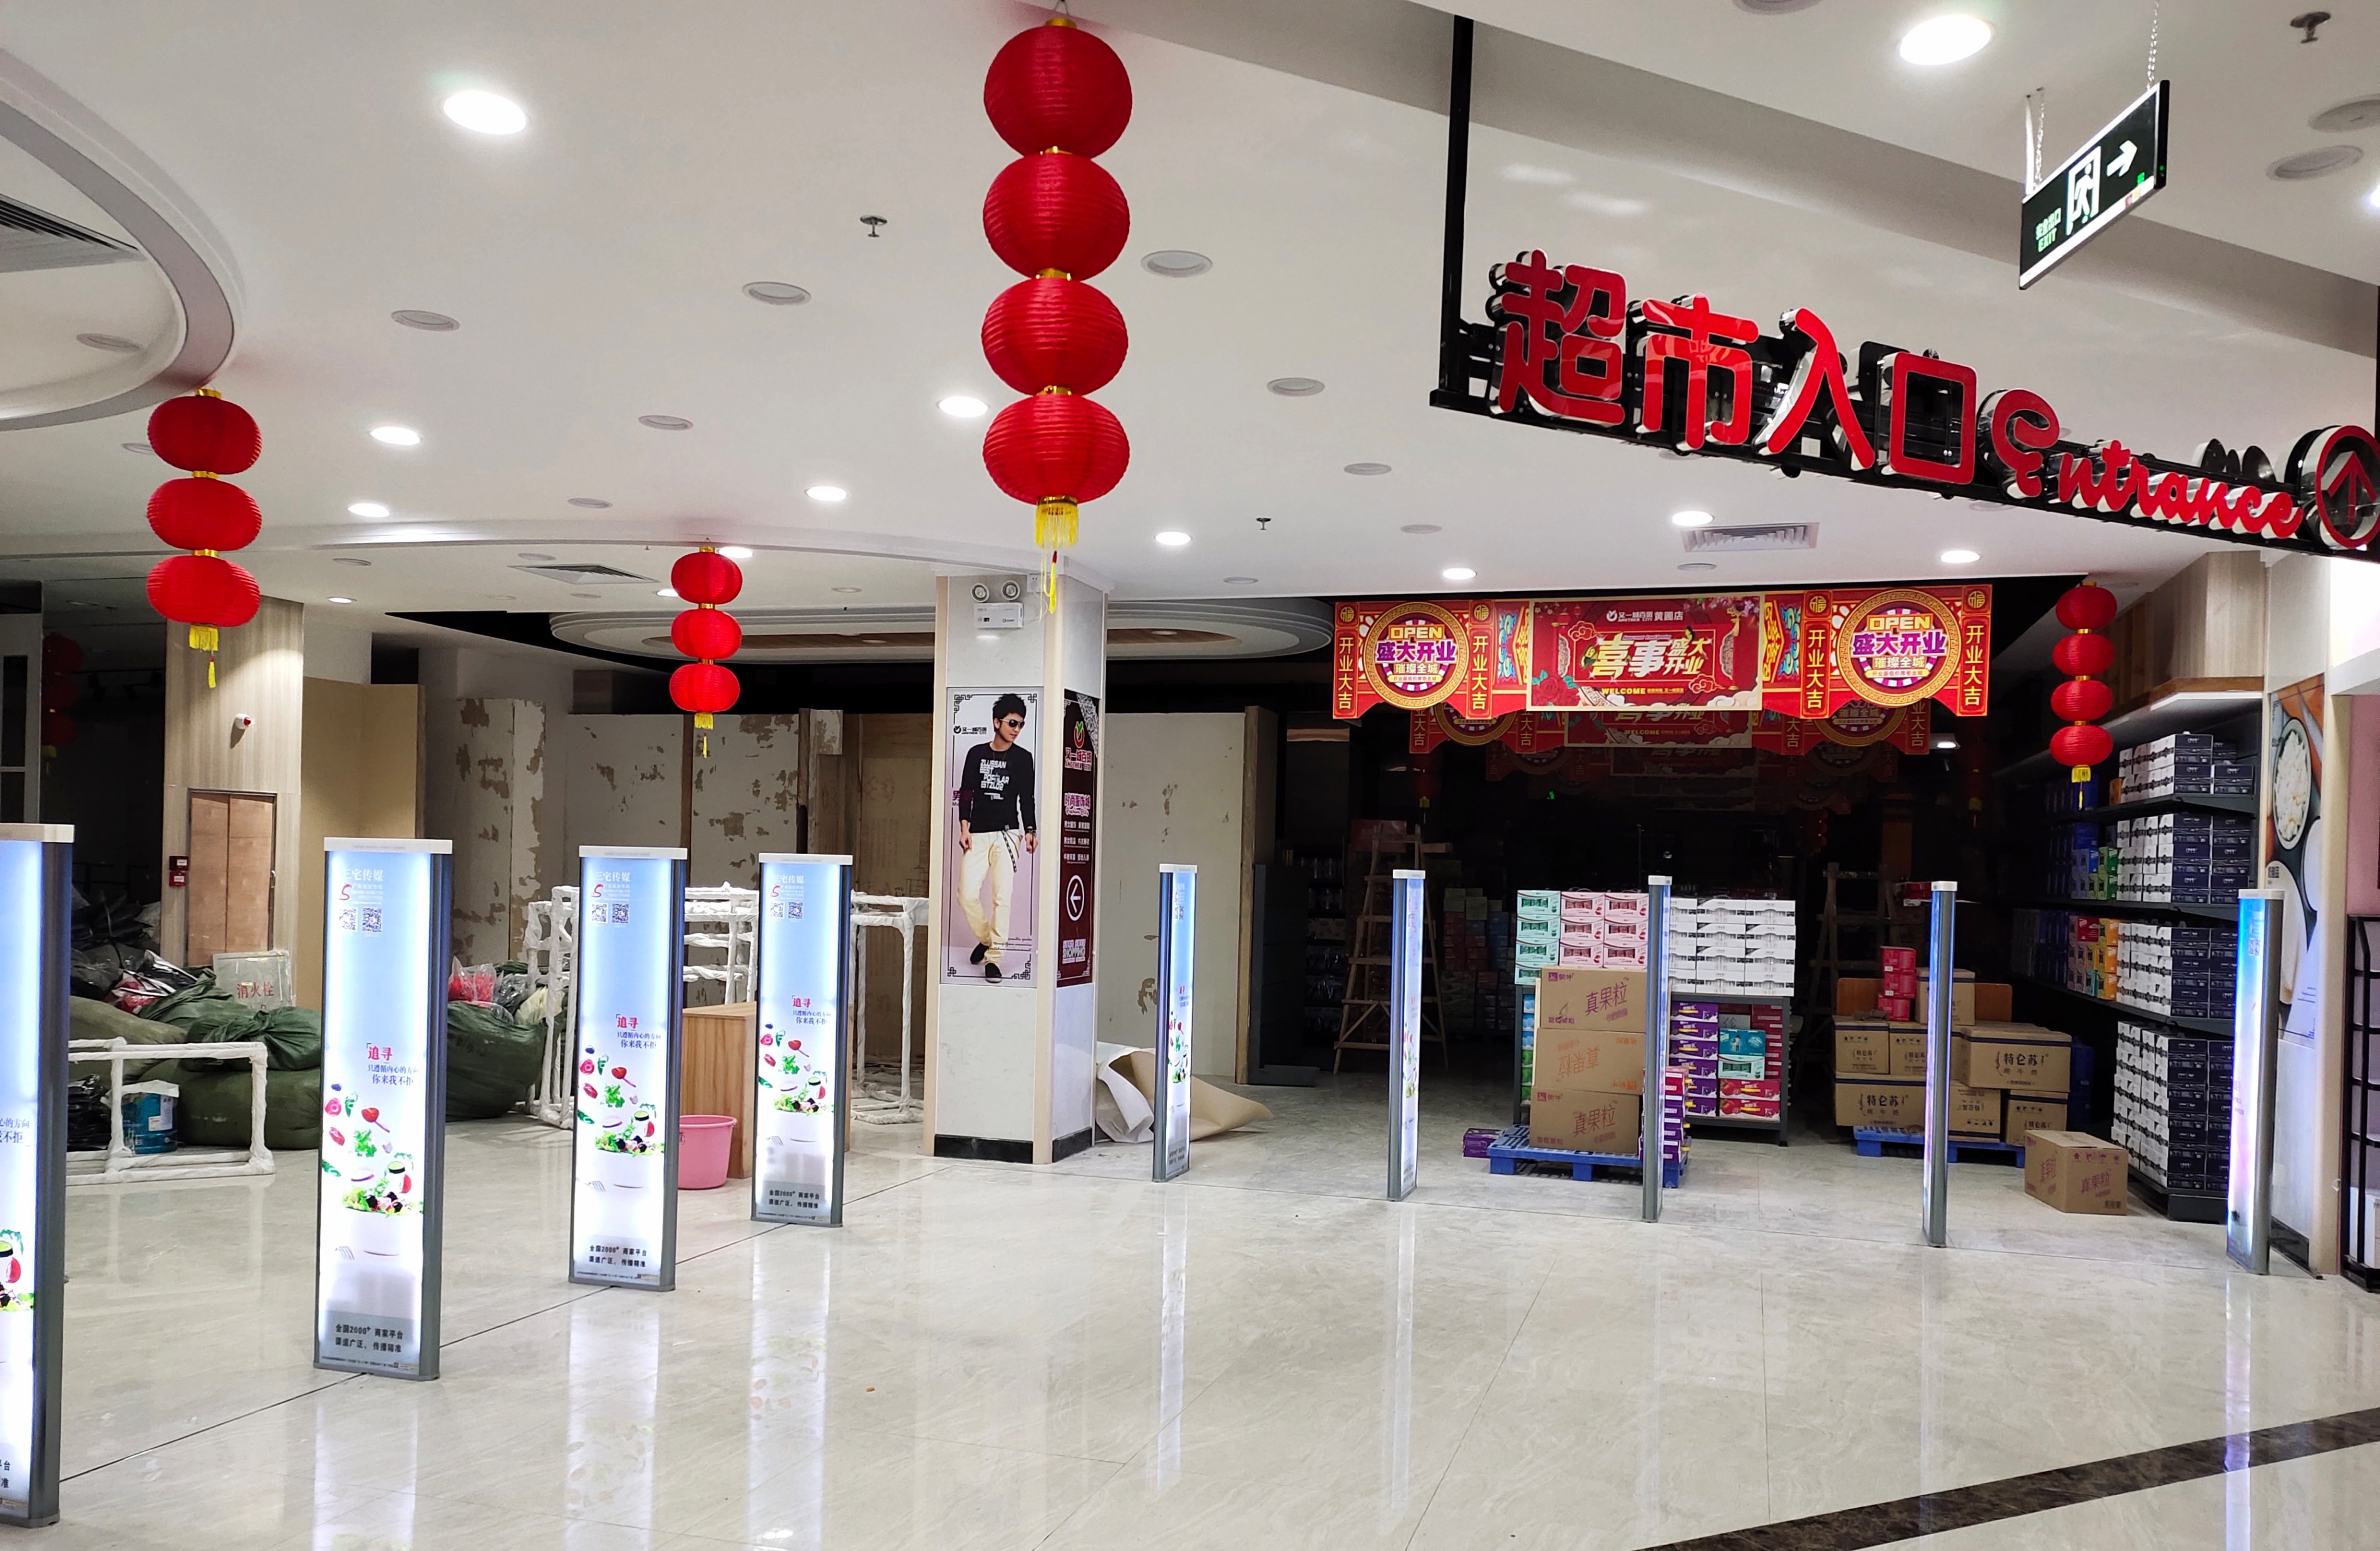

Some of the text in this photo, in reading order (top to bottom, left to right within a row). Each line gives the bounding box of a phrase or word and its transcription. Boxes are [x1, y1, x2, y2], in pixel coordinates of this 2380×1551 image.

[2037, 227, 2057, 253] EXIT
[1499, 248, 1977, 485] 超市入口
[1992, 388, 2304, 540] Entrance
[1390, 626, 1443, 639] OPEN
[1869, 616, 1932, 630] OPEN
[1376, 641, 1457, 662] 盛大开业
[1664, 637, 1710, 657] 盛大
[1852, 631, 1947, 656] 盛大开业
[1591, 632, 1671, 679] 喜事
[1873, 656, 1925, 668] 璀璨全城
[1963, 624, 1985, 706] 开业大吉
[1338, 637, 1354, 710] 开业大吉
[1395, 662, 1440, 674] 璀璨全城
[1472, 636, 1489, 710] 开业大吉
[1662, 657, 1705, 676] 开业
[1806, 629, 1826, 709] 开业大吉
[980, 765, 995, 774] BEST
[236, 981, 274, 999] 消火栓
[1585, 981, 1628, 1017] 真果粒
[2004, 1053, 2038, 1066] 特仑苏
[1866, 1094, 1899, 1107] 特仑苏
[1573, 1103, 1616, 1138] 真果粒
[0, 1130, 23, 1144] 不拒
[374, 1327, 404, 1340] 商家平台
